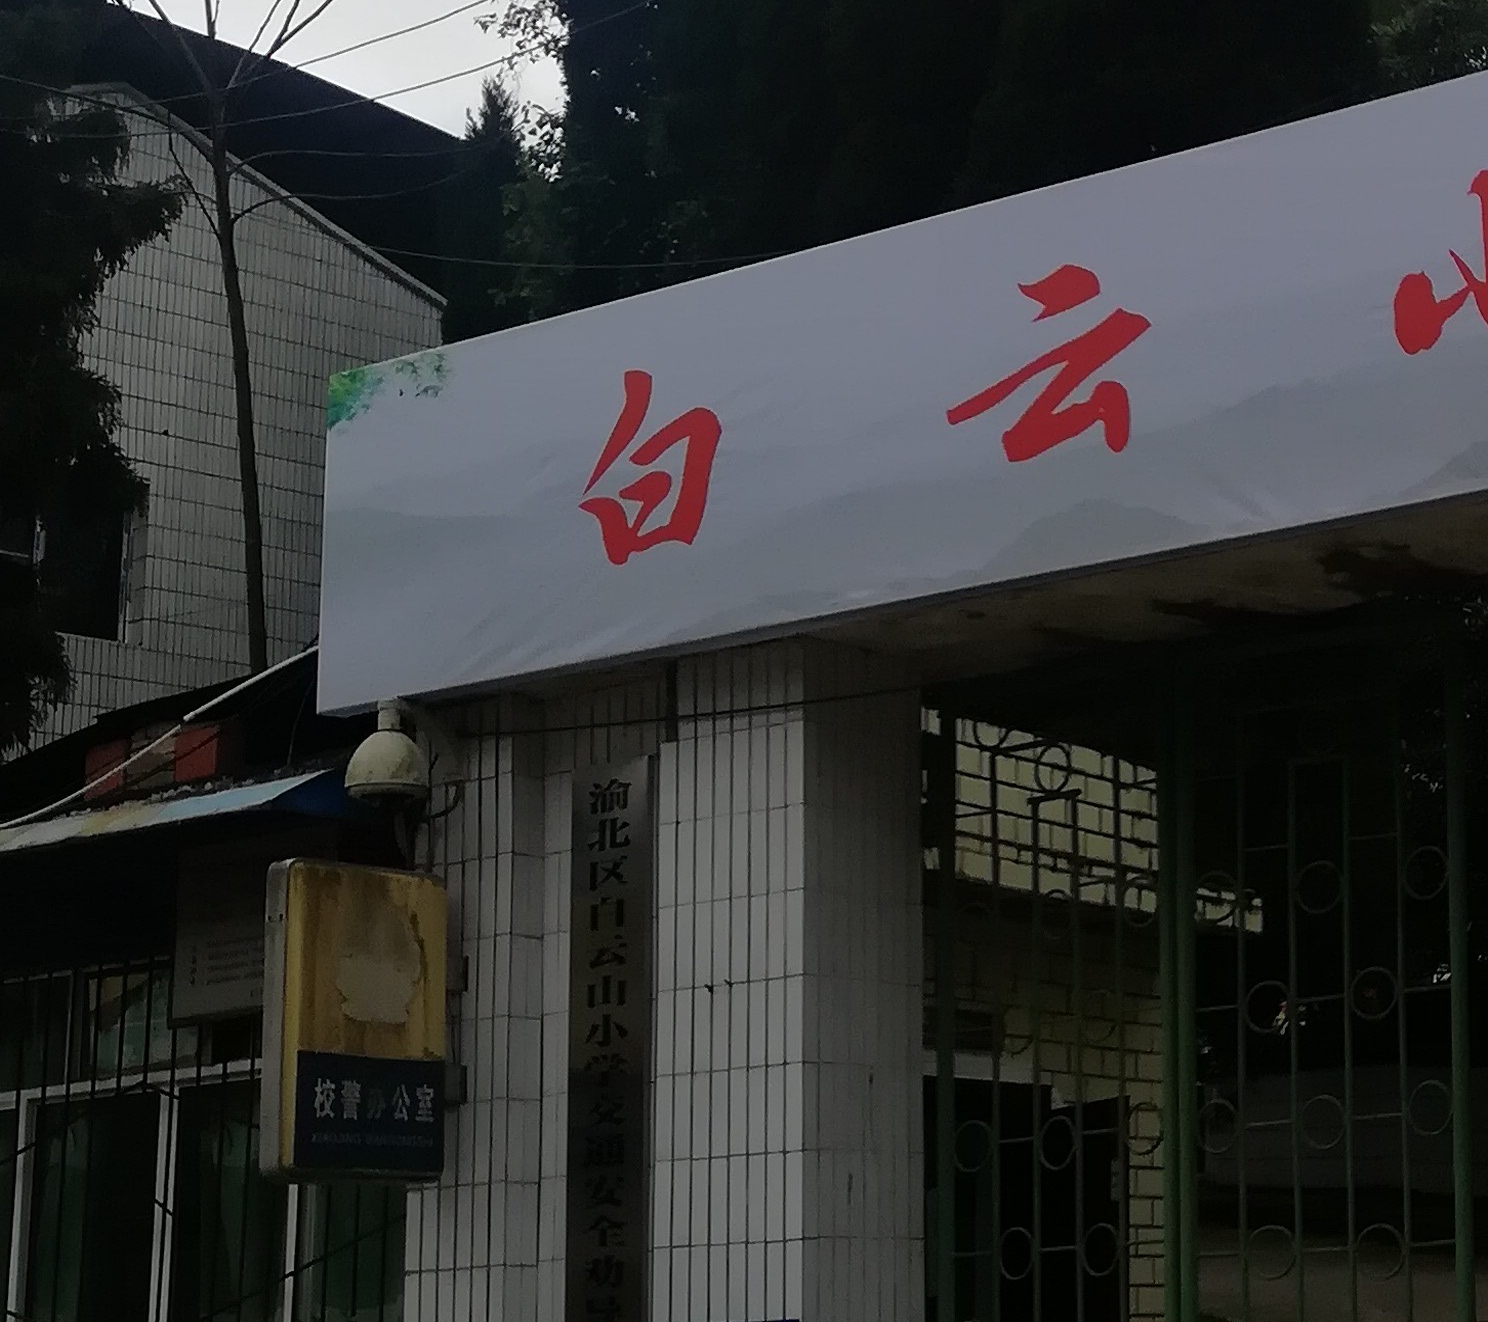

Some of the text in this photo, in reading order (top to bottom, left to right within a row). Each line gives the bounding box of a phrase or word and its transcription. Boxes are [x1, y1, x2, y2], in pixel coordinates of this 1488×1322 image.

[312, 1077, 435, 1123] 校警办公室
